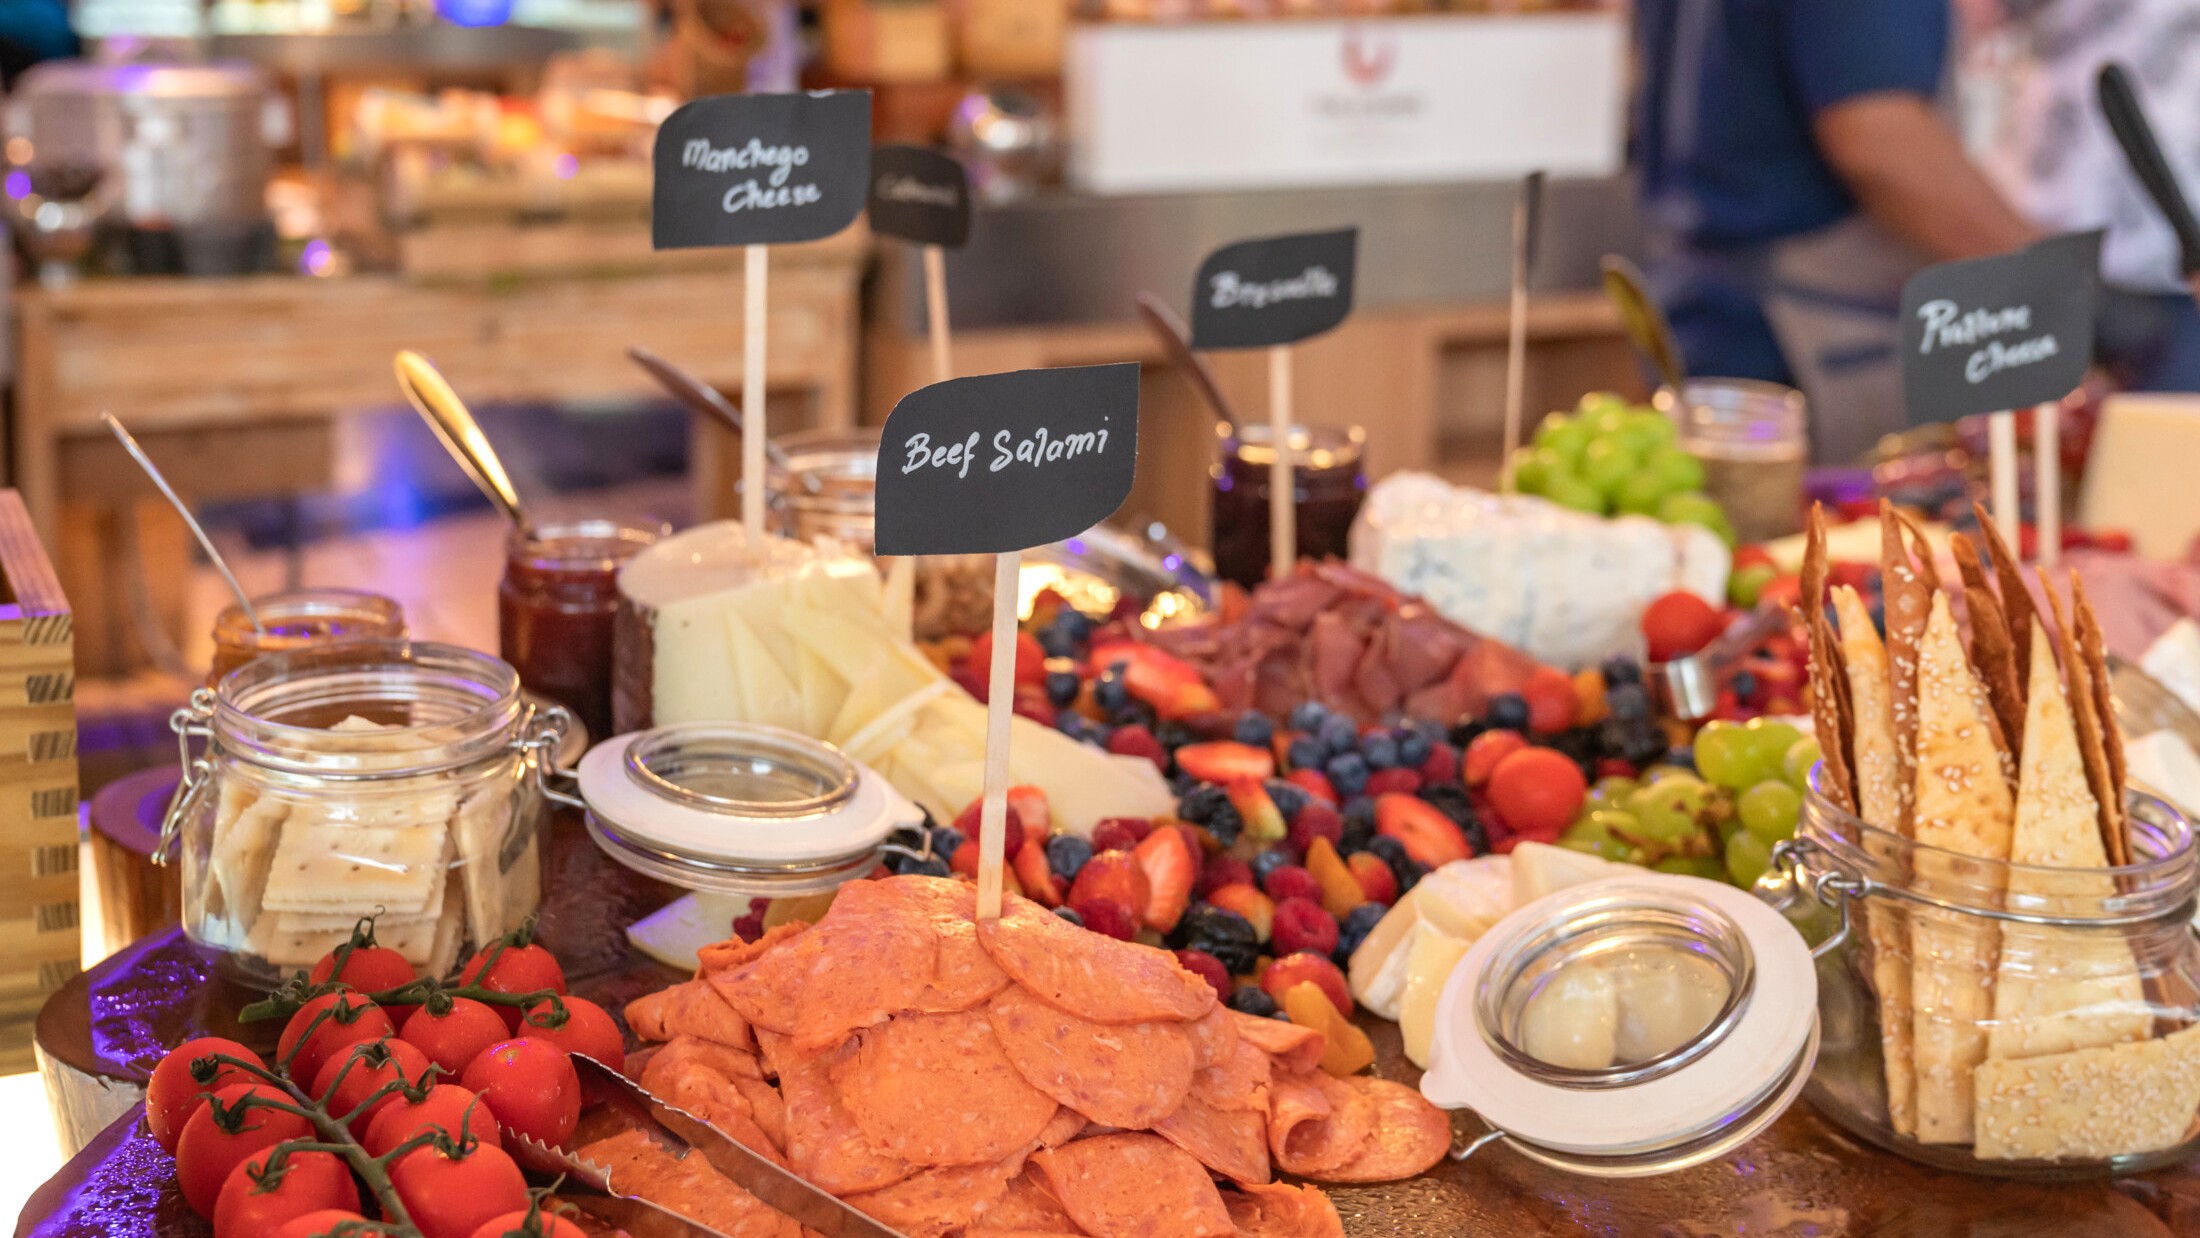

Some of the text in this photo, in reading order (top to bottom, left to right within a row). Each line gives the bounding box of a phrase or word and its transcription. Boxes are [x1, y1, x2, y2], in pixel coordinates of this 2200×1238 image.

[683, 137, 809, 187] Manchego
[722, 178, 821, 213] Cheese
[902, 416, 1109, 479] Beef Salami
